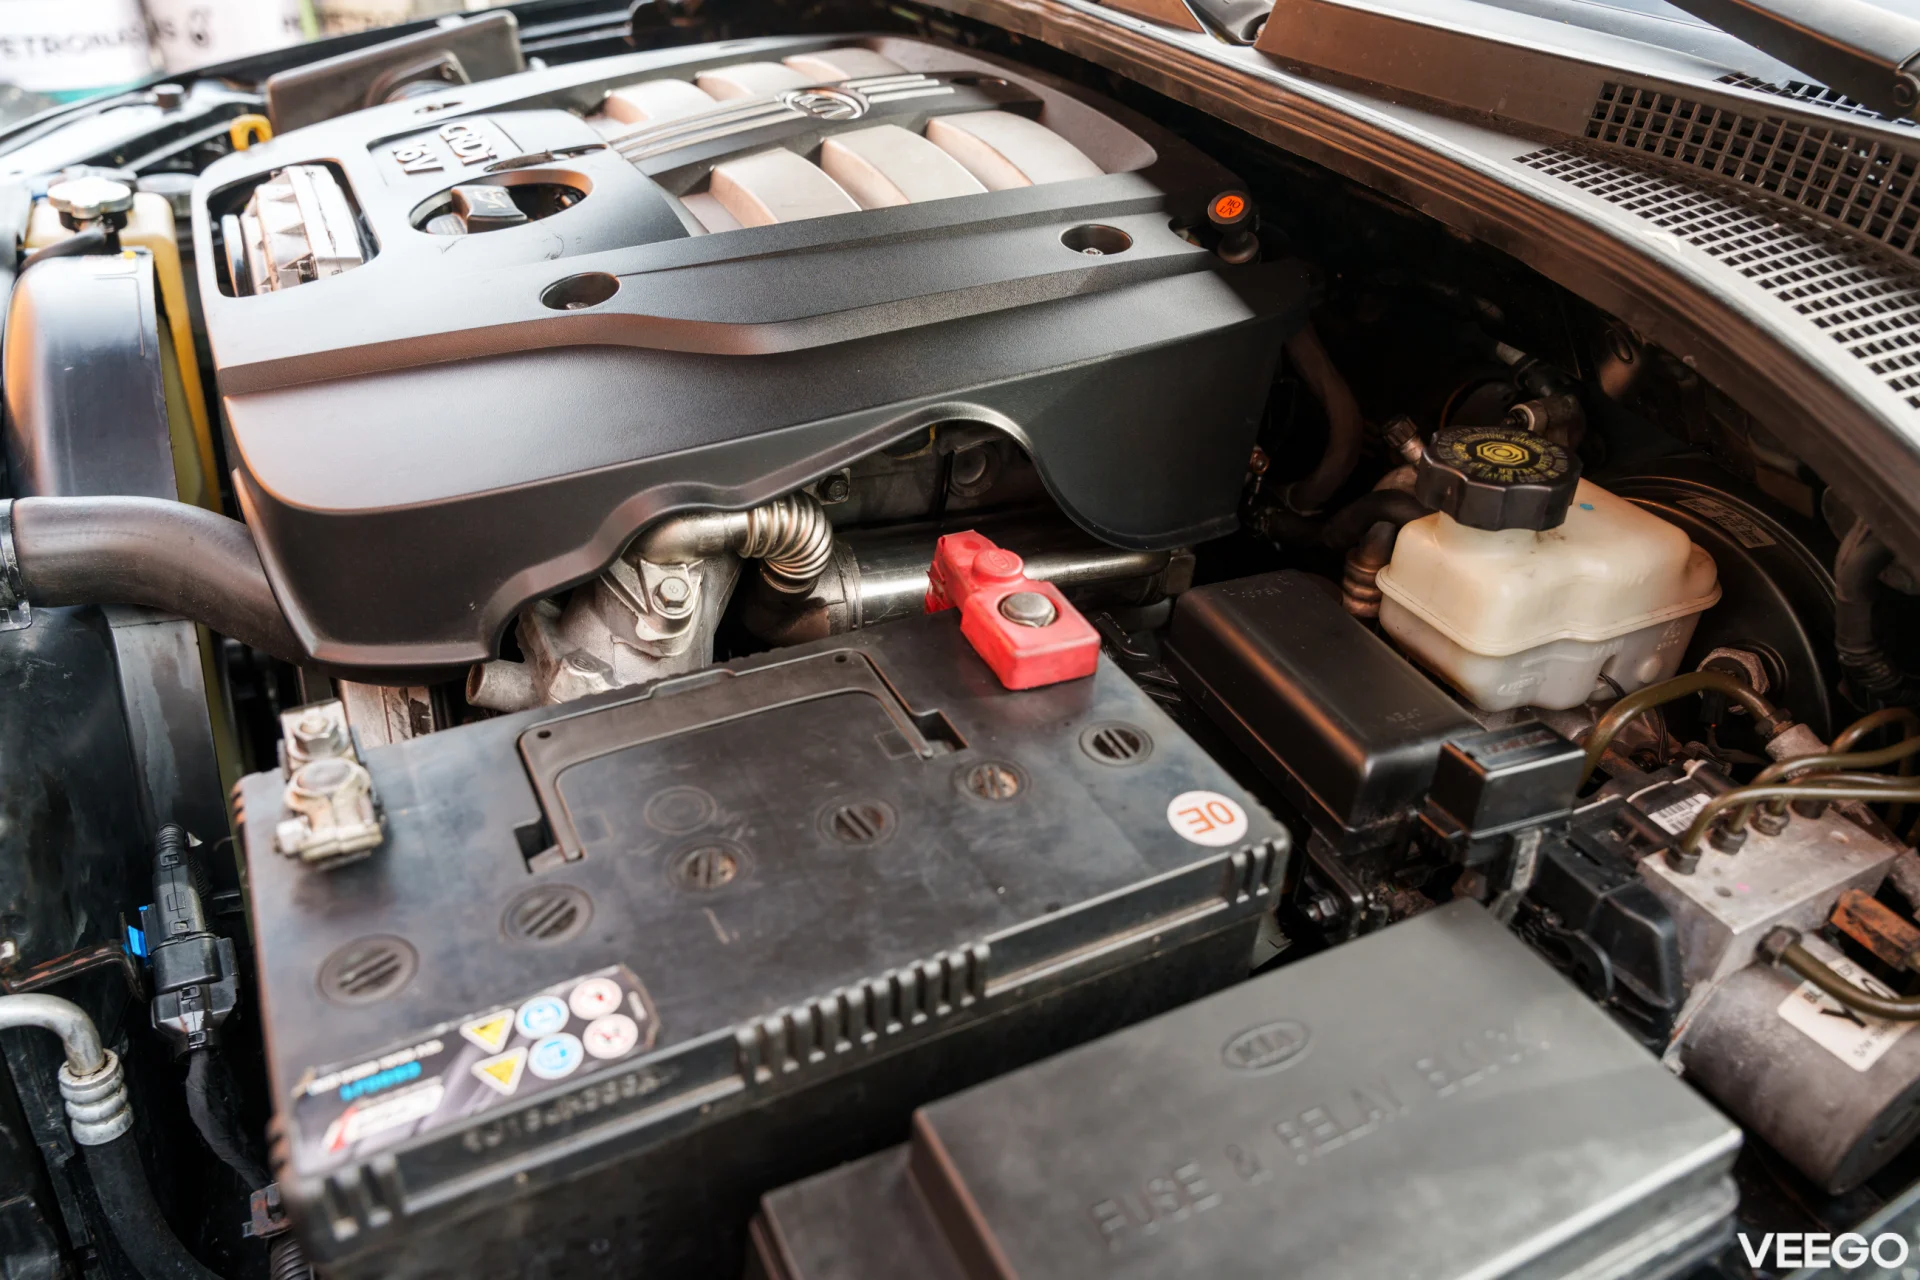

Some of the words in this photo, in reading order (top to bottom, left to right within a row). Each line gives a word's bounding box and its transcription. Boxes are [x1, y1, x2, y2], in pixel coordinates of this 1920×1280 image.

[392, 141, 445, 175] 16V
[1227, 198, 1241, 209] OIL
[1177, 801, 1235, 835] OE
[1236, 1029, 1297, 1062] KIA
[1090, 1160, 1222, 1247] FUSE
[1224, 1144, 1273, 1186] &
[1274, 1072, 1410, 1166] RELAY
